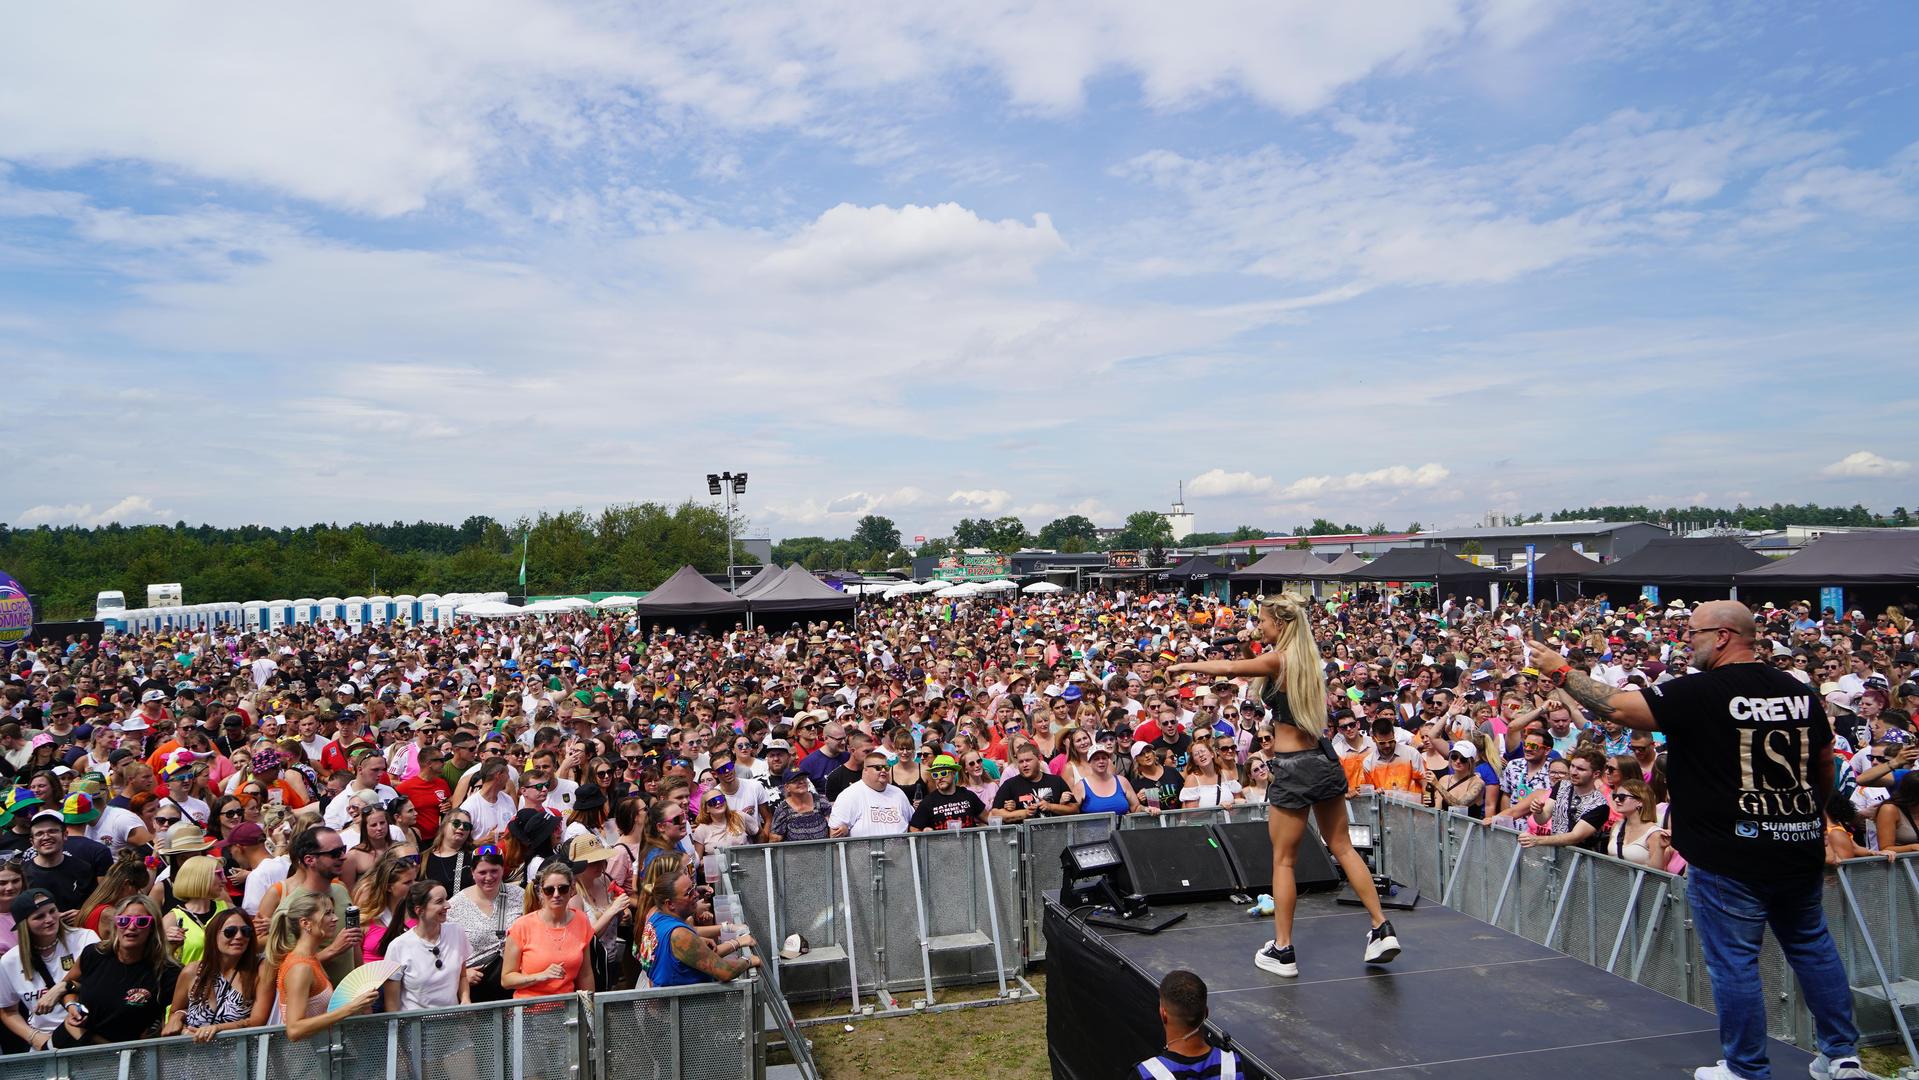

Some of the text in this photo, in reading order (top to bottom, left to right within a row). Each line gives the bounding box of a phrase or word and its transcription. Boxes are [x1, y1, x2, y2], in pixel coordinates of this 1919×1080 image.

[964, 556, 997, 565] PIZZA
[968, 567, 995, 575] PIZZA
[0, 612, 31, 627] OMMER
[1729, 695, 1810, 721] CREW
[1736, 727, 1812, 792] ISI
[871, 809, 900, 823] BOSS
[1773, 830, 1821, 842] BOOKING
